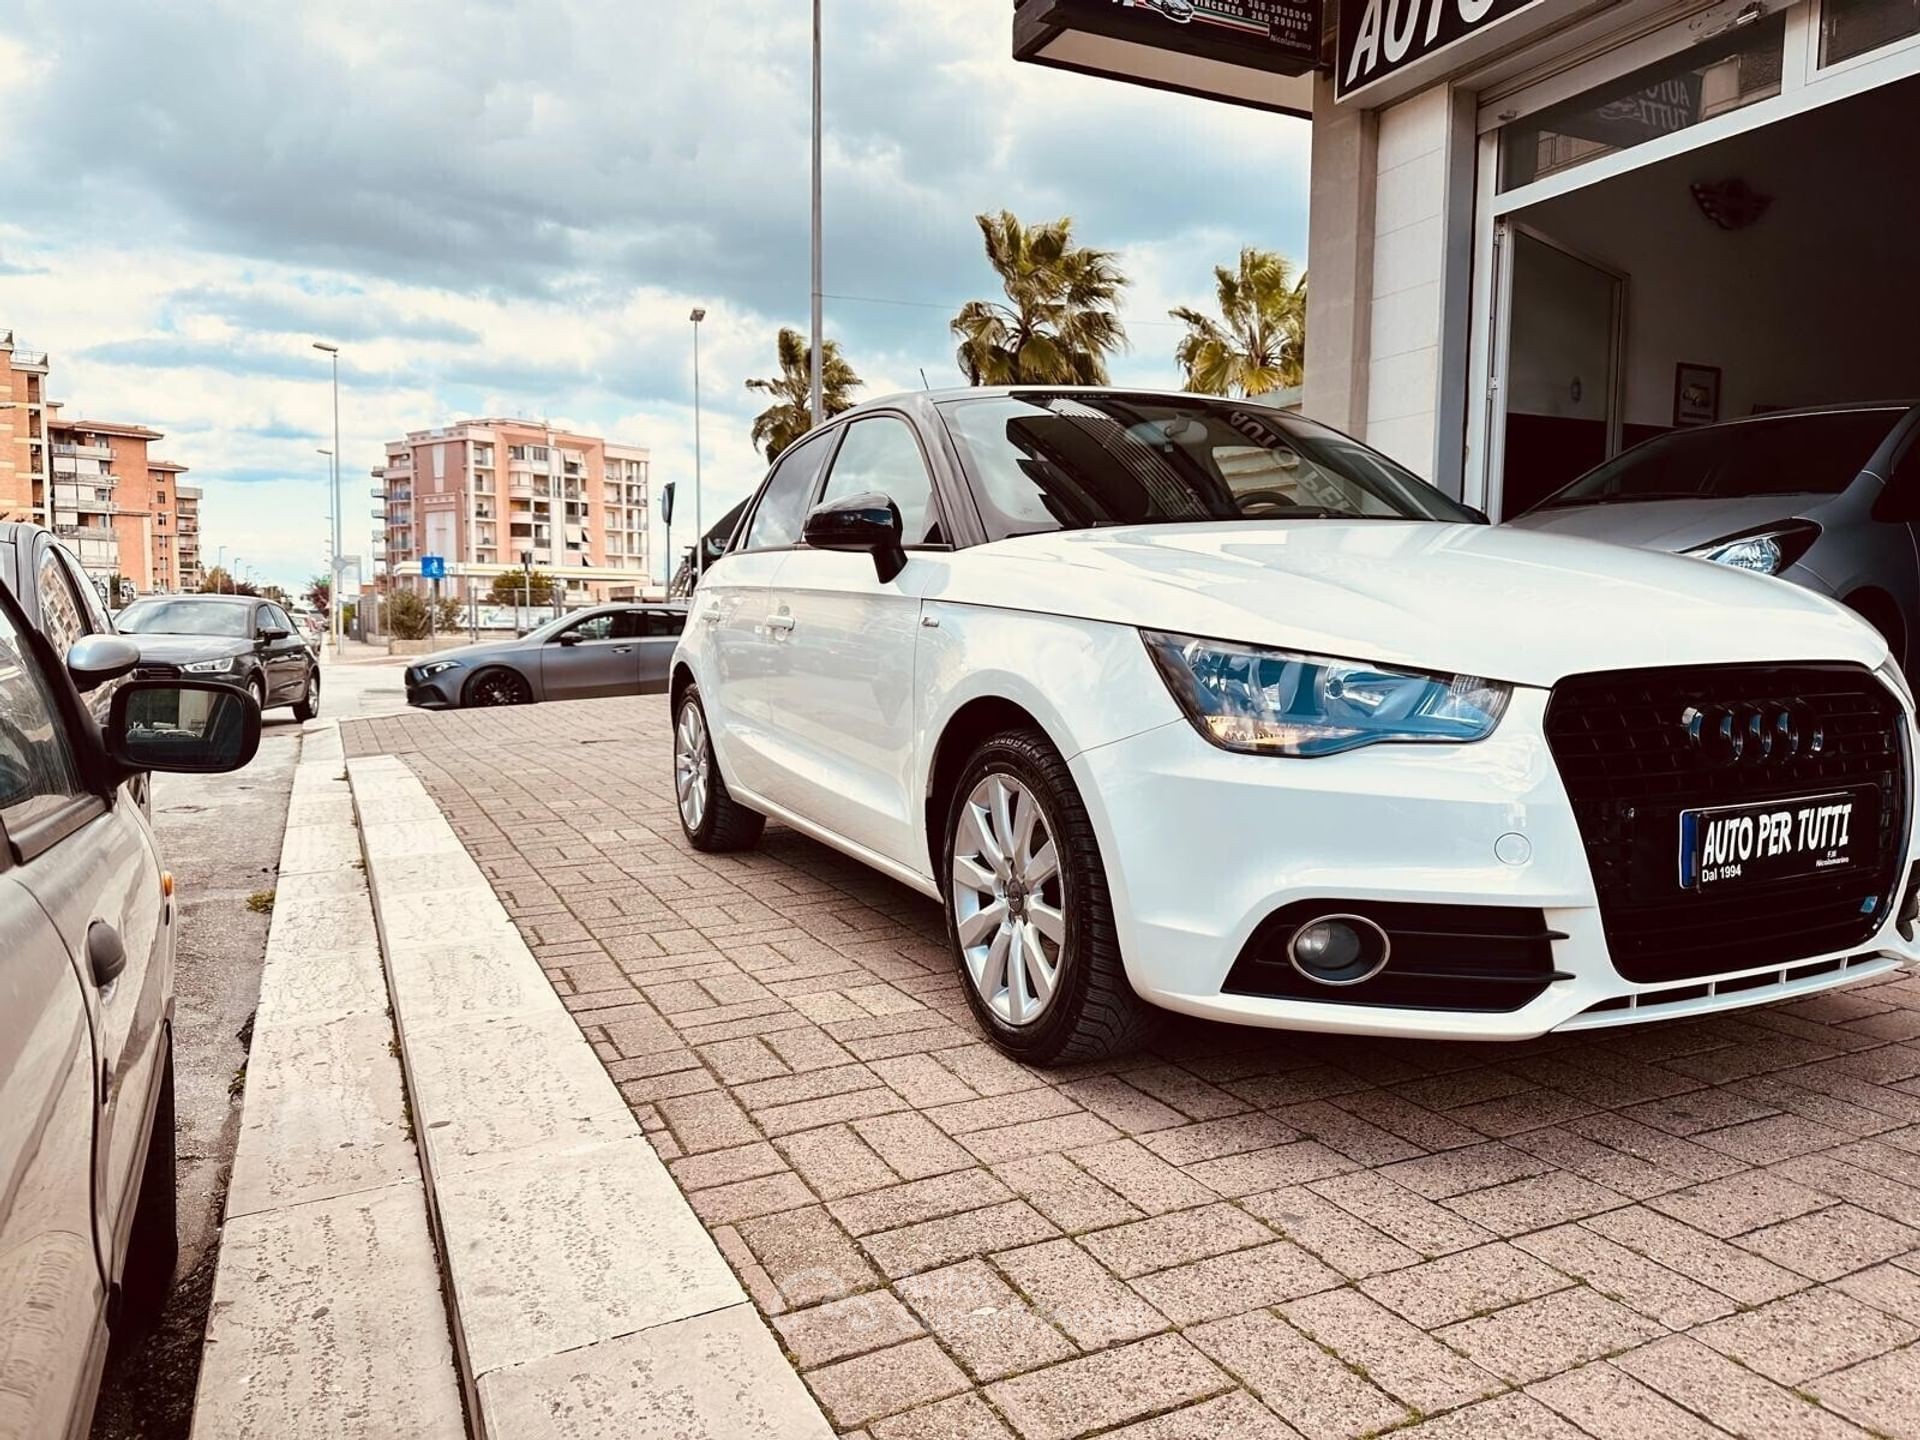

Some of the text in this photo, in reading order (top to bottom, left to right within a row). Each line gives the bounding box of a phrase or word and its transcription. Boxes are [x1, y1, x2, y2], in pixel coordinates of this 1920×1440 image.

[1344, 0, 1494, 87] AU
[1702, 803, 1853, 867] AUTO PER TUTTI
[1701, 864, 1742, 882] Dal 1994
